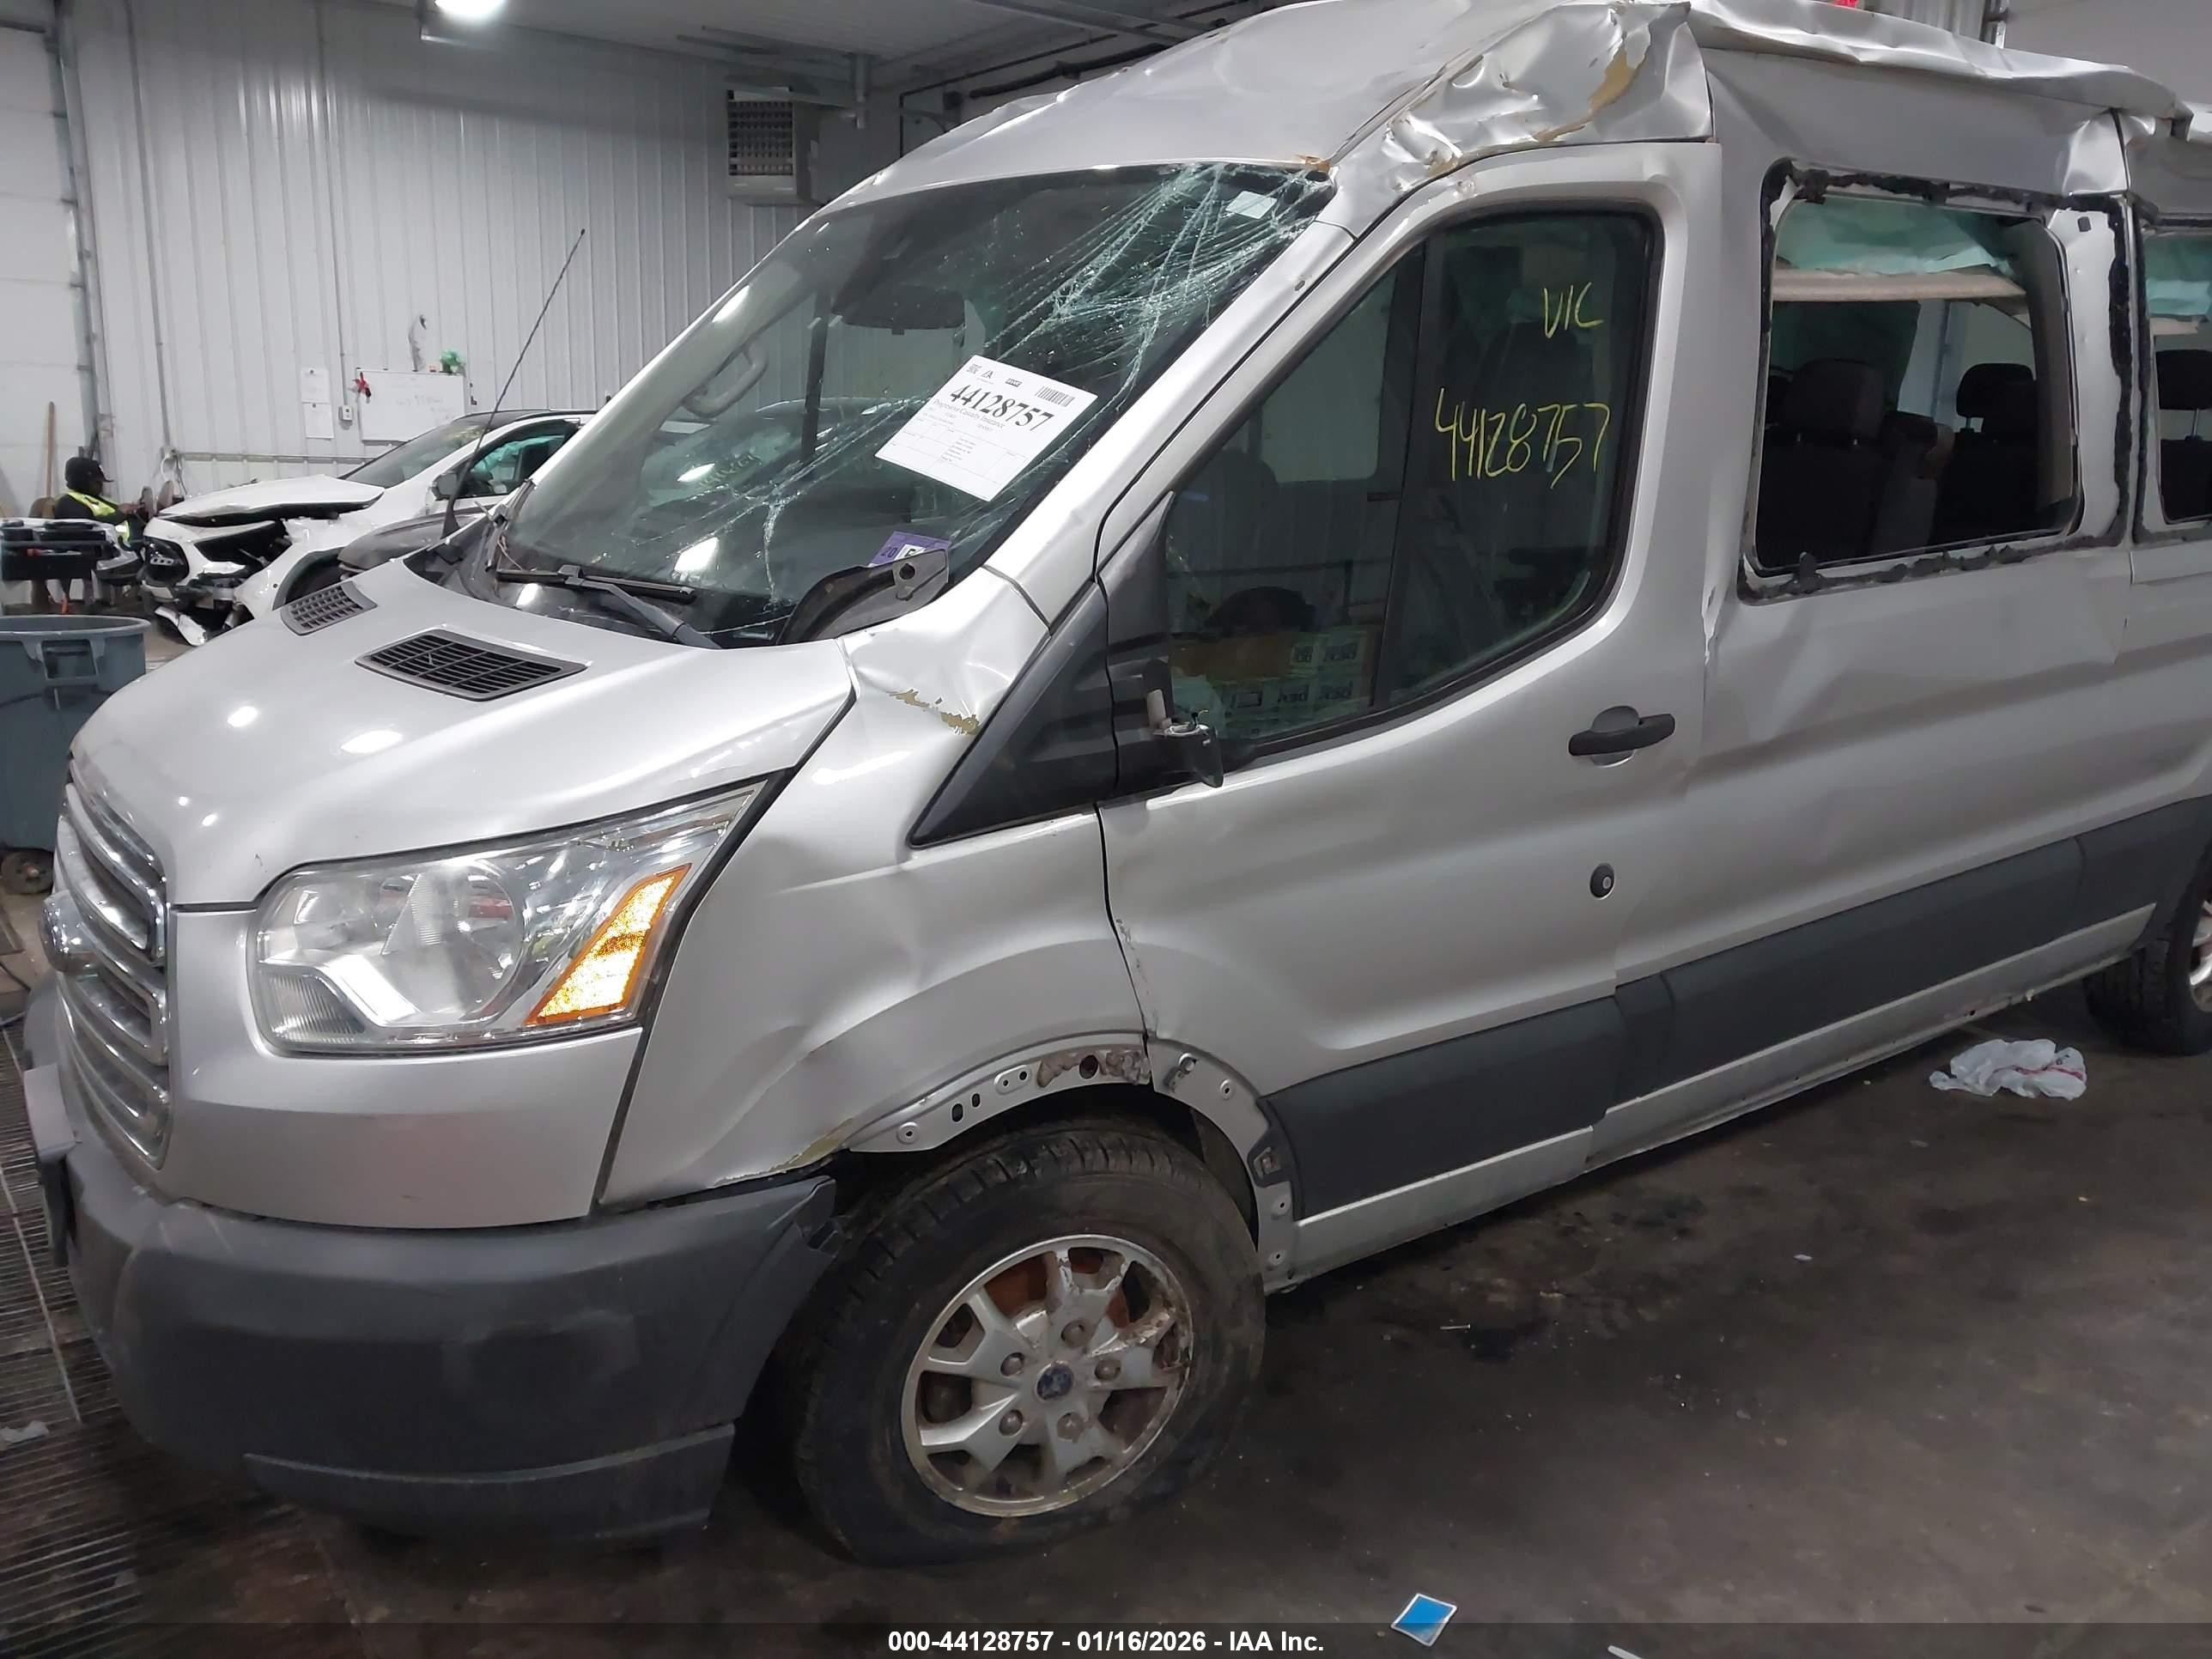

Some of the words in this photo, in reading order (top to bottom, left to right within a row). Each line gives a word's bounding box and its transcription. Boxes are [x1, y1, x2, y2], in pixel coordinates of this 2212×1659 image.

[1543, 282, 1603, 338] VIC
[949, 384, 1054, 432] 44128757
[1436, 388, 1609, 489] 44128757
